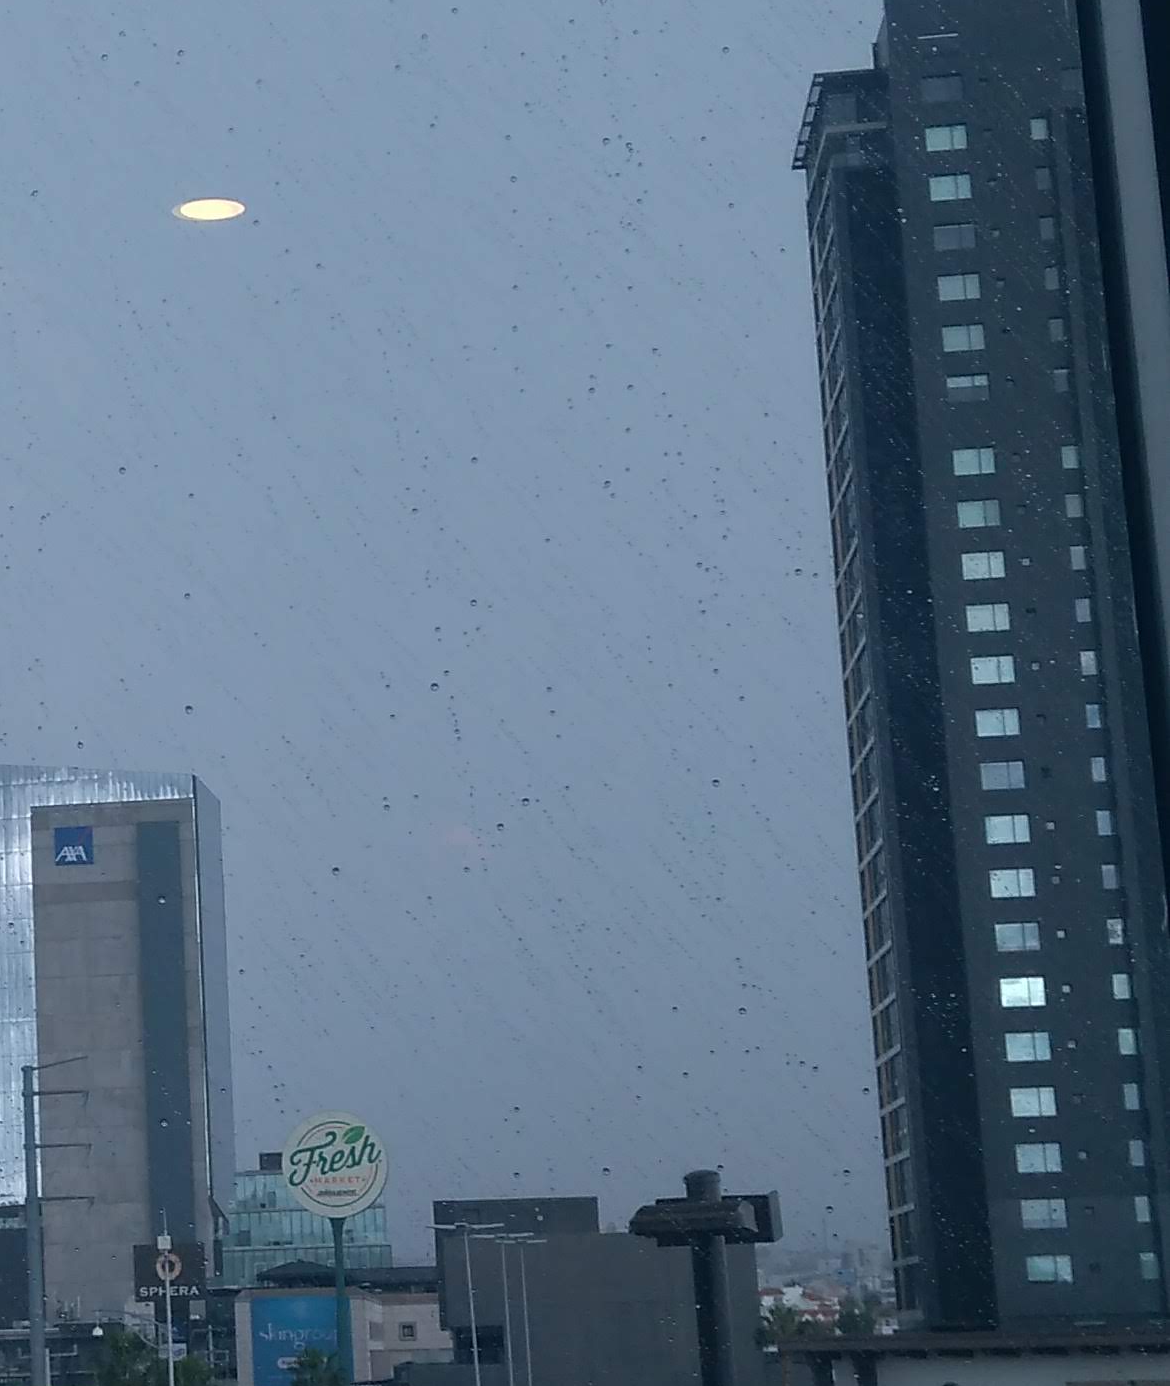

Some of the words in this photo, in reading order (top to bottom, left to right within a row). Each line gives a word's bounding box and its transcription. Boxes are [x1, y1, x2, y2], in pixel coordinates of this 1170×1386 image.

[55, 845, 88, 863] AXA
[289, 1130, 382, 1187] Fresh
[314, 1175, 361, 1184] MARKET
[139, 1285, 200, 1297] SPHERA
[258, 1322, 338, 1351] skingrou
